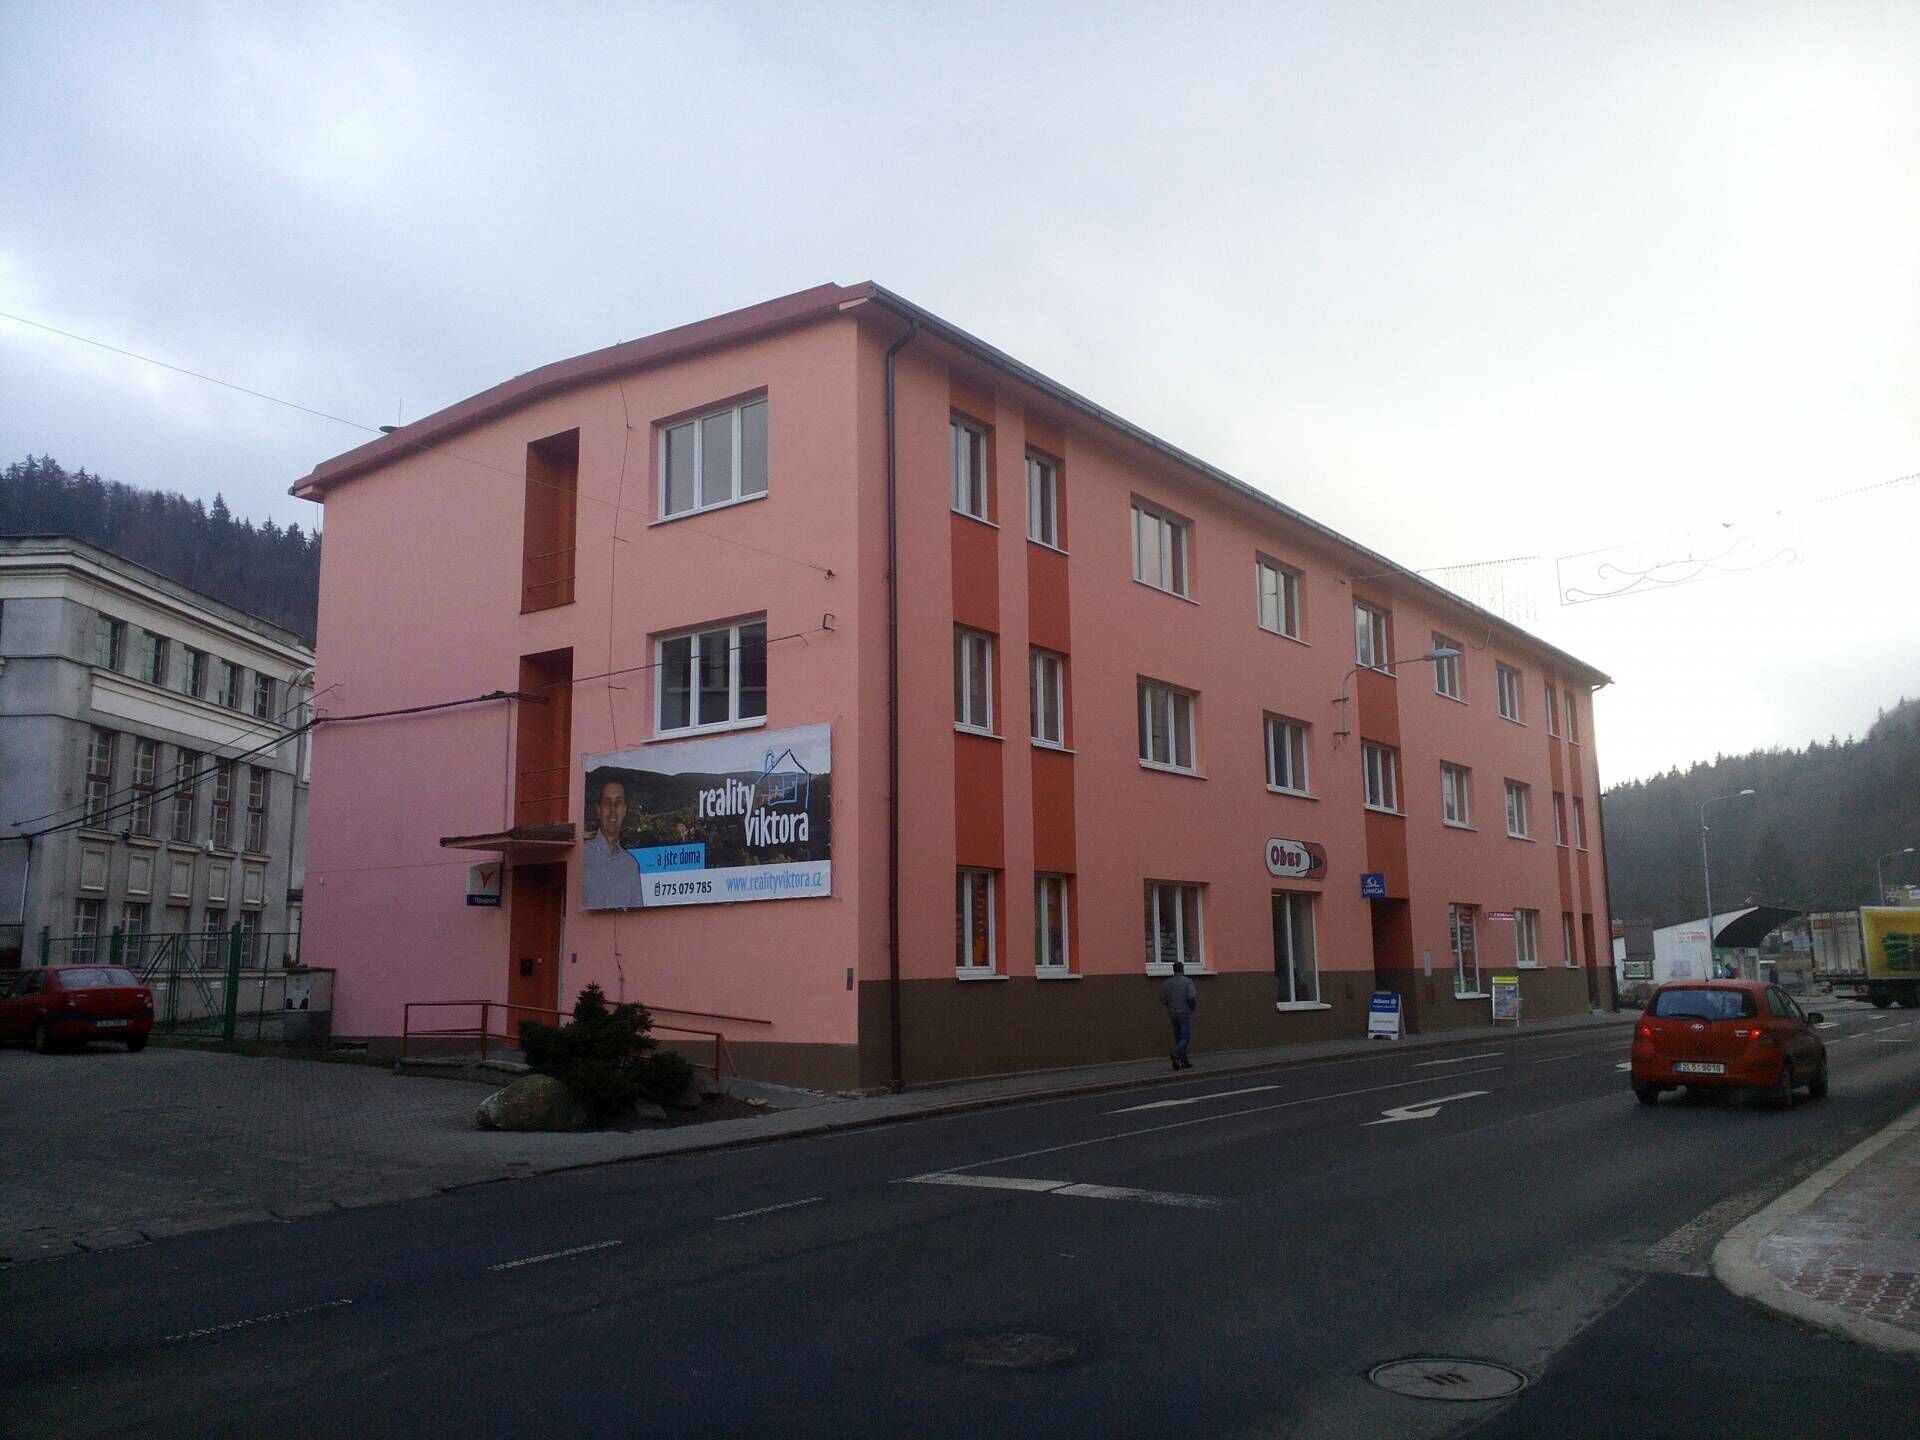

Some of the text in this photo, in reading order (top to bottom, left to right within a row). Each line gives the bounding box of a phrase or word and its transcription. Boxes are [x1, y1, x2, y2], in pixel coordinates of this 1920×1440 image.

[698, 778, 756, 819] reality
[744, 807, 809, 847] viktora
[663, 849, 678, 870] jste
[679, 848, 701, 865] doma
[661, 881, 712, 896] 775 079 785
[726, 869, 822, 893] www.realityviktora.cz
